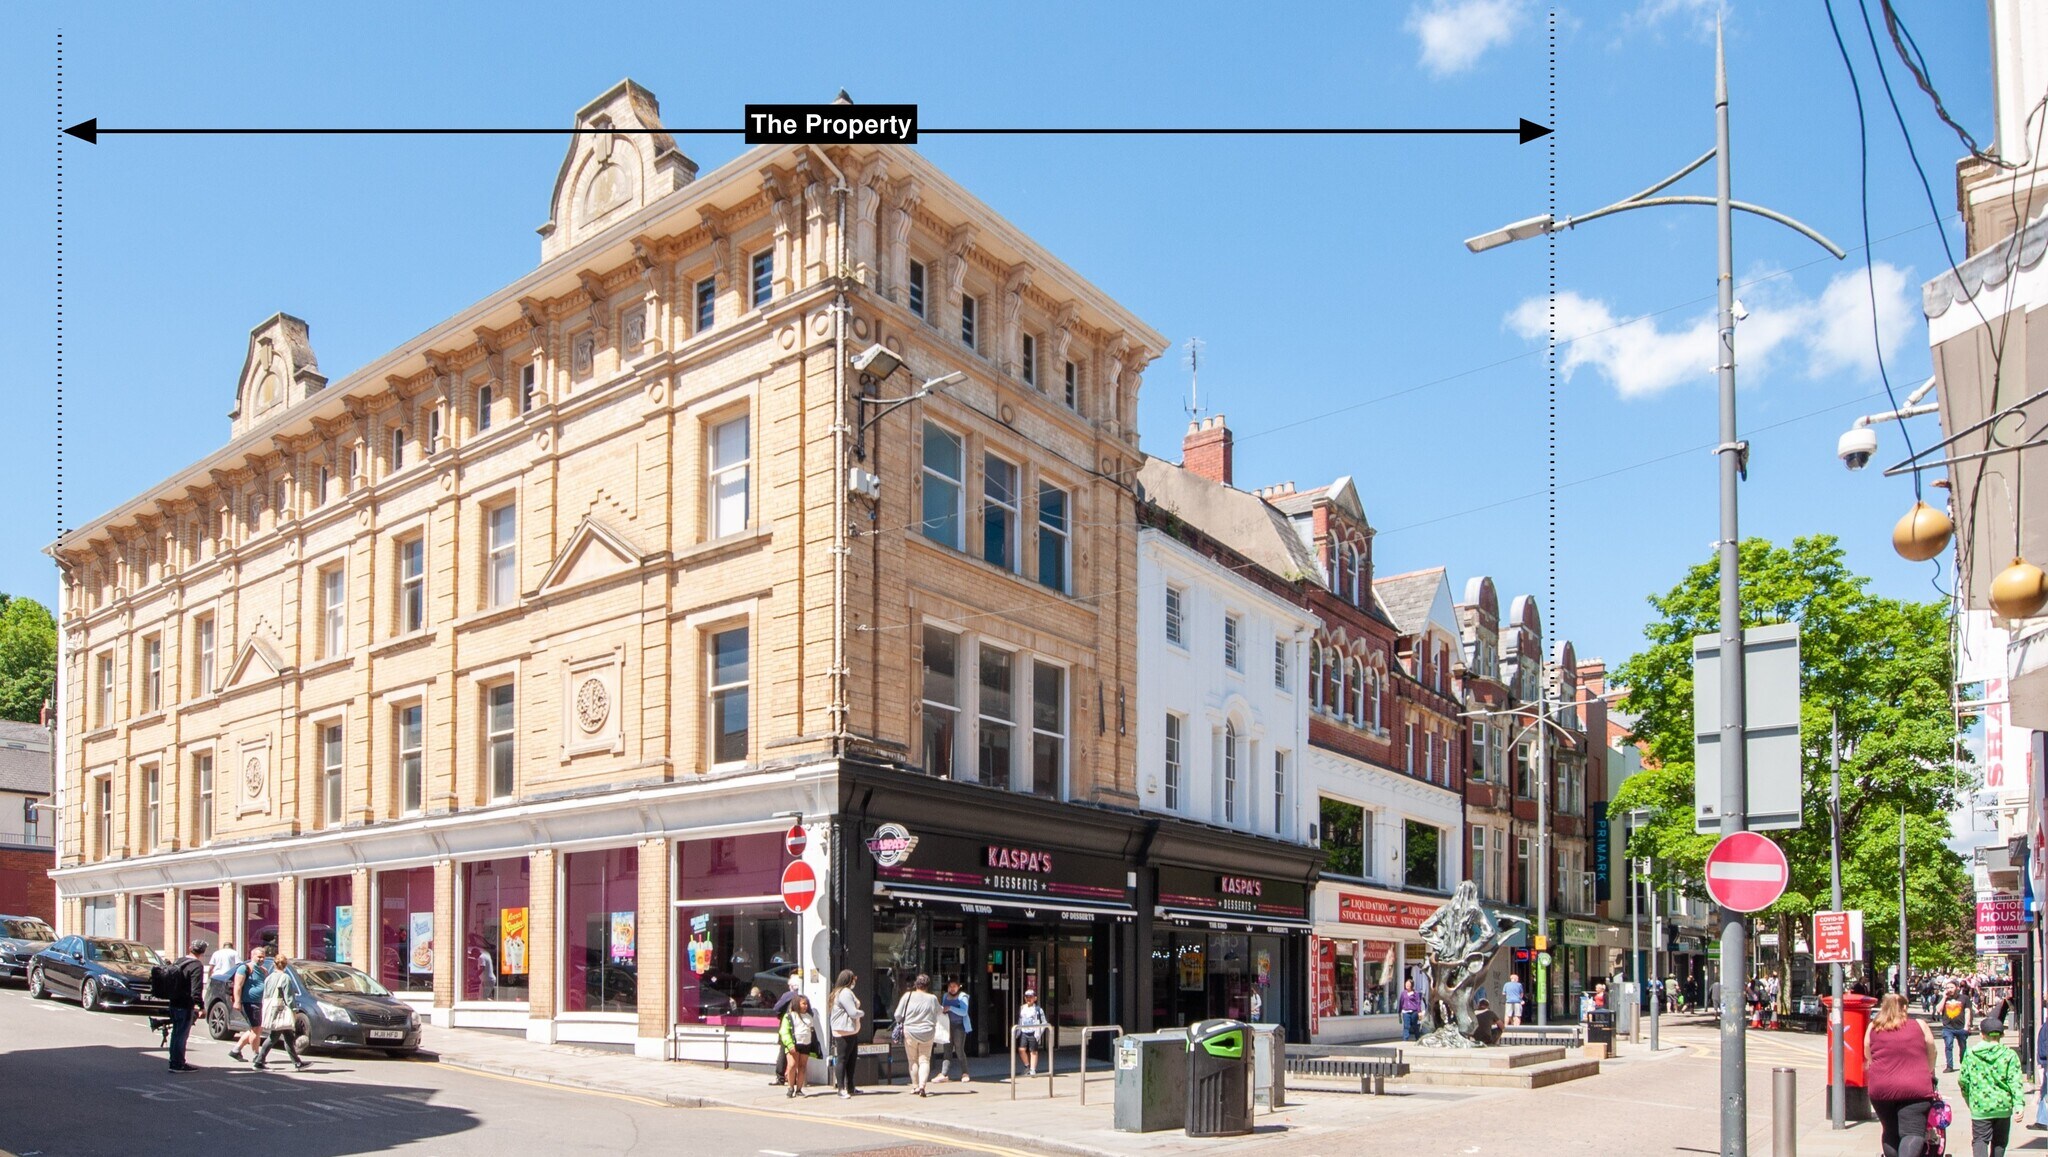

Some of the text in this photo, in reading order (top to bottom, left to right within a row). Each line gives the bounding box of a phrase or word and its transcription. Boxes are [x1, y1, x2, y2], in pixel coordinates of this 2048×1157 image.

[1597, 820, 1607, 881] PRIMARK
[988, 846, 1052, 873] KASPA'S
[993, 875, 1038, 891] DESSERTS
[1221, 876, 1262, 896] KASPA'S
[960, 904, 975, 913] THE
[975, 905, 992, 914] KING
[1069, 912, 1095, 921] DESSERTS
[1223, 899, 1252, 911] DESSERTS
[1351, 899, 1388, 911] LIQUIDATION
[1342, 910, 1397, 924] STOCK CLEARANCE
[1401, 917, 1419, 926] STOCK
